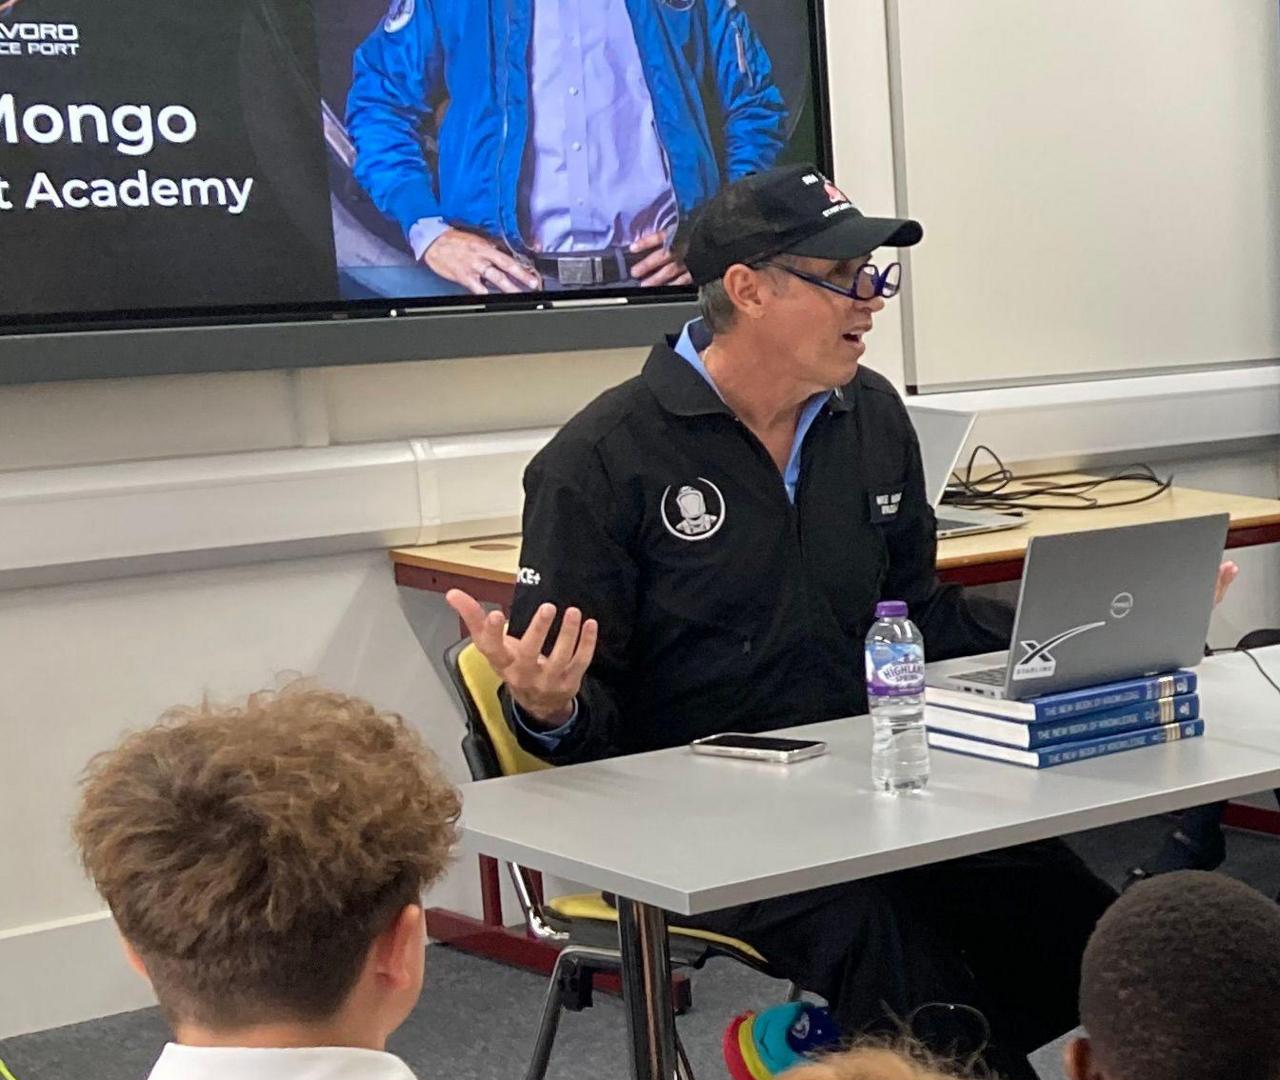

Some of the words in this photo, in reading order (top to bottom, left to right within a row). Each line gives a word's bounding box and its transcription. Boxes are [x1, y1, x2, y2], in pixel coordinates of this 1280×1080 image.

[0, 23, 78, 41] VORD
[28, 43, 79, 56] PORT
[25, 168, 254, 214] Academy
